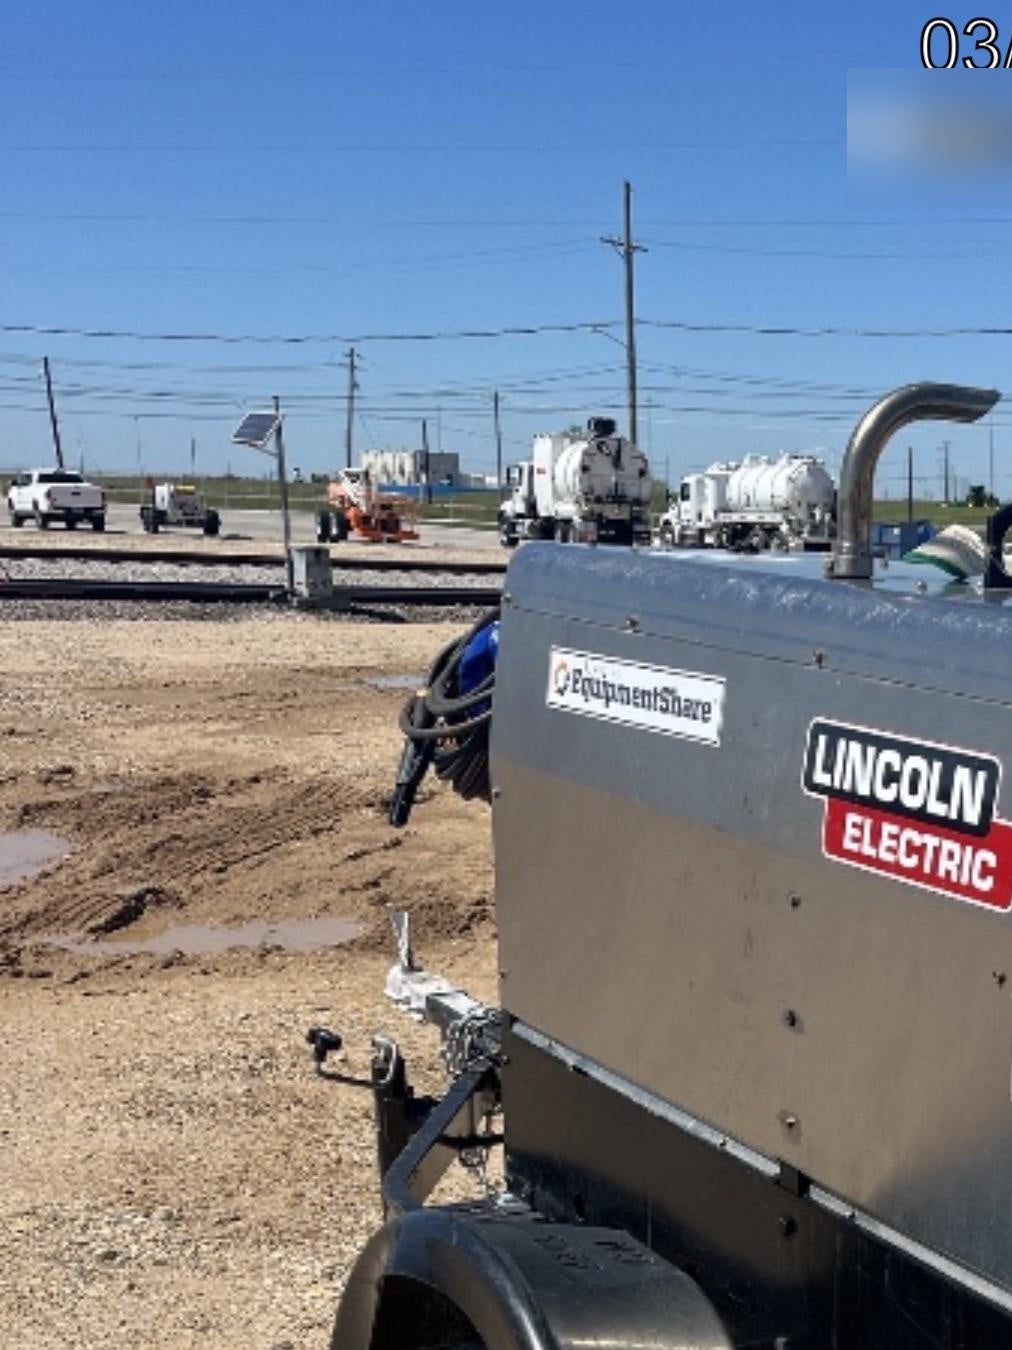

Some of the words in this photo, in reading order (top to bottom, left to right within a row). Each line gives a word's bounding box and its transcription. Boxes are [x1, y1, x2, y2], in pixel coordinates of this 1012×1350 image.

[571, 668, 712, 723] EquipmentShare
[812, 734, 988, 826] LINCOLN
[842, 813, 997, 892] ELECTRIC
